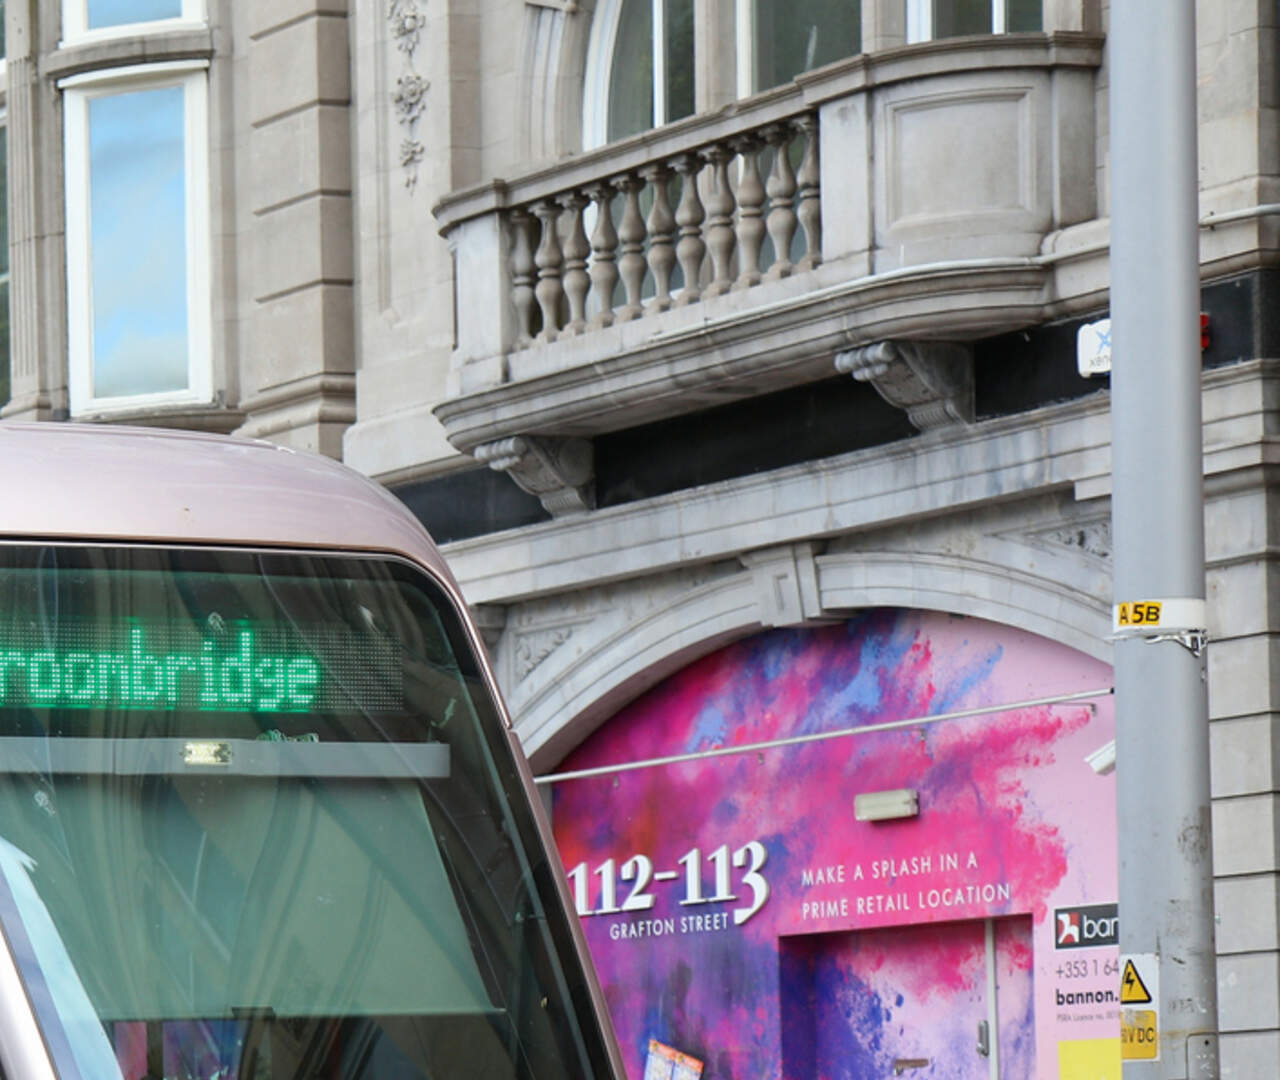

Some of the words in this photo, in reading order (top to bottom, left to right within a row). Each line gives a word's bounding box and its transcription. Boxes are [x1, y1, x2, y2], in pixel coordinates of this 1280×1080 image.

[567, 841, 770, 925] 112-113
[801, 865, 846, 886] MAKE
[853, 864, 865, 881] A
[871, 856, 932, 880] SPLASH
[940, 853, 959, 872] IN
[966, 851, 979, 869] A
[802, 898, 849, 920] PRIME
[856, 893, 910, 915] RETAIL
[918, 883, 1011, 908] LOCATION
[609, 918, 675, 940] GRAFTON
[680, 913, 729, 934] STREET
[1056, 960, 1089, 979] +353
